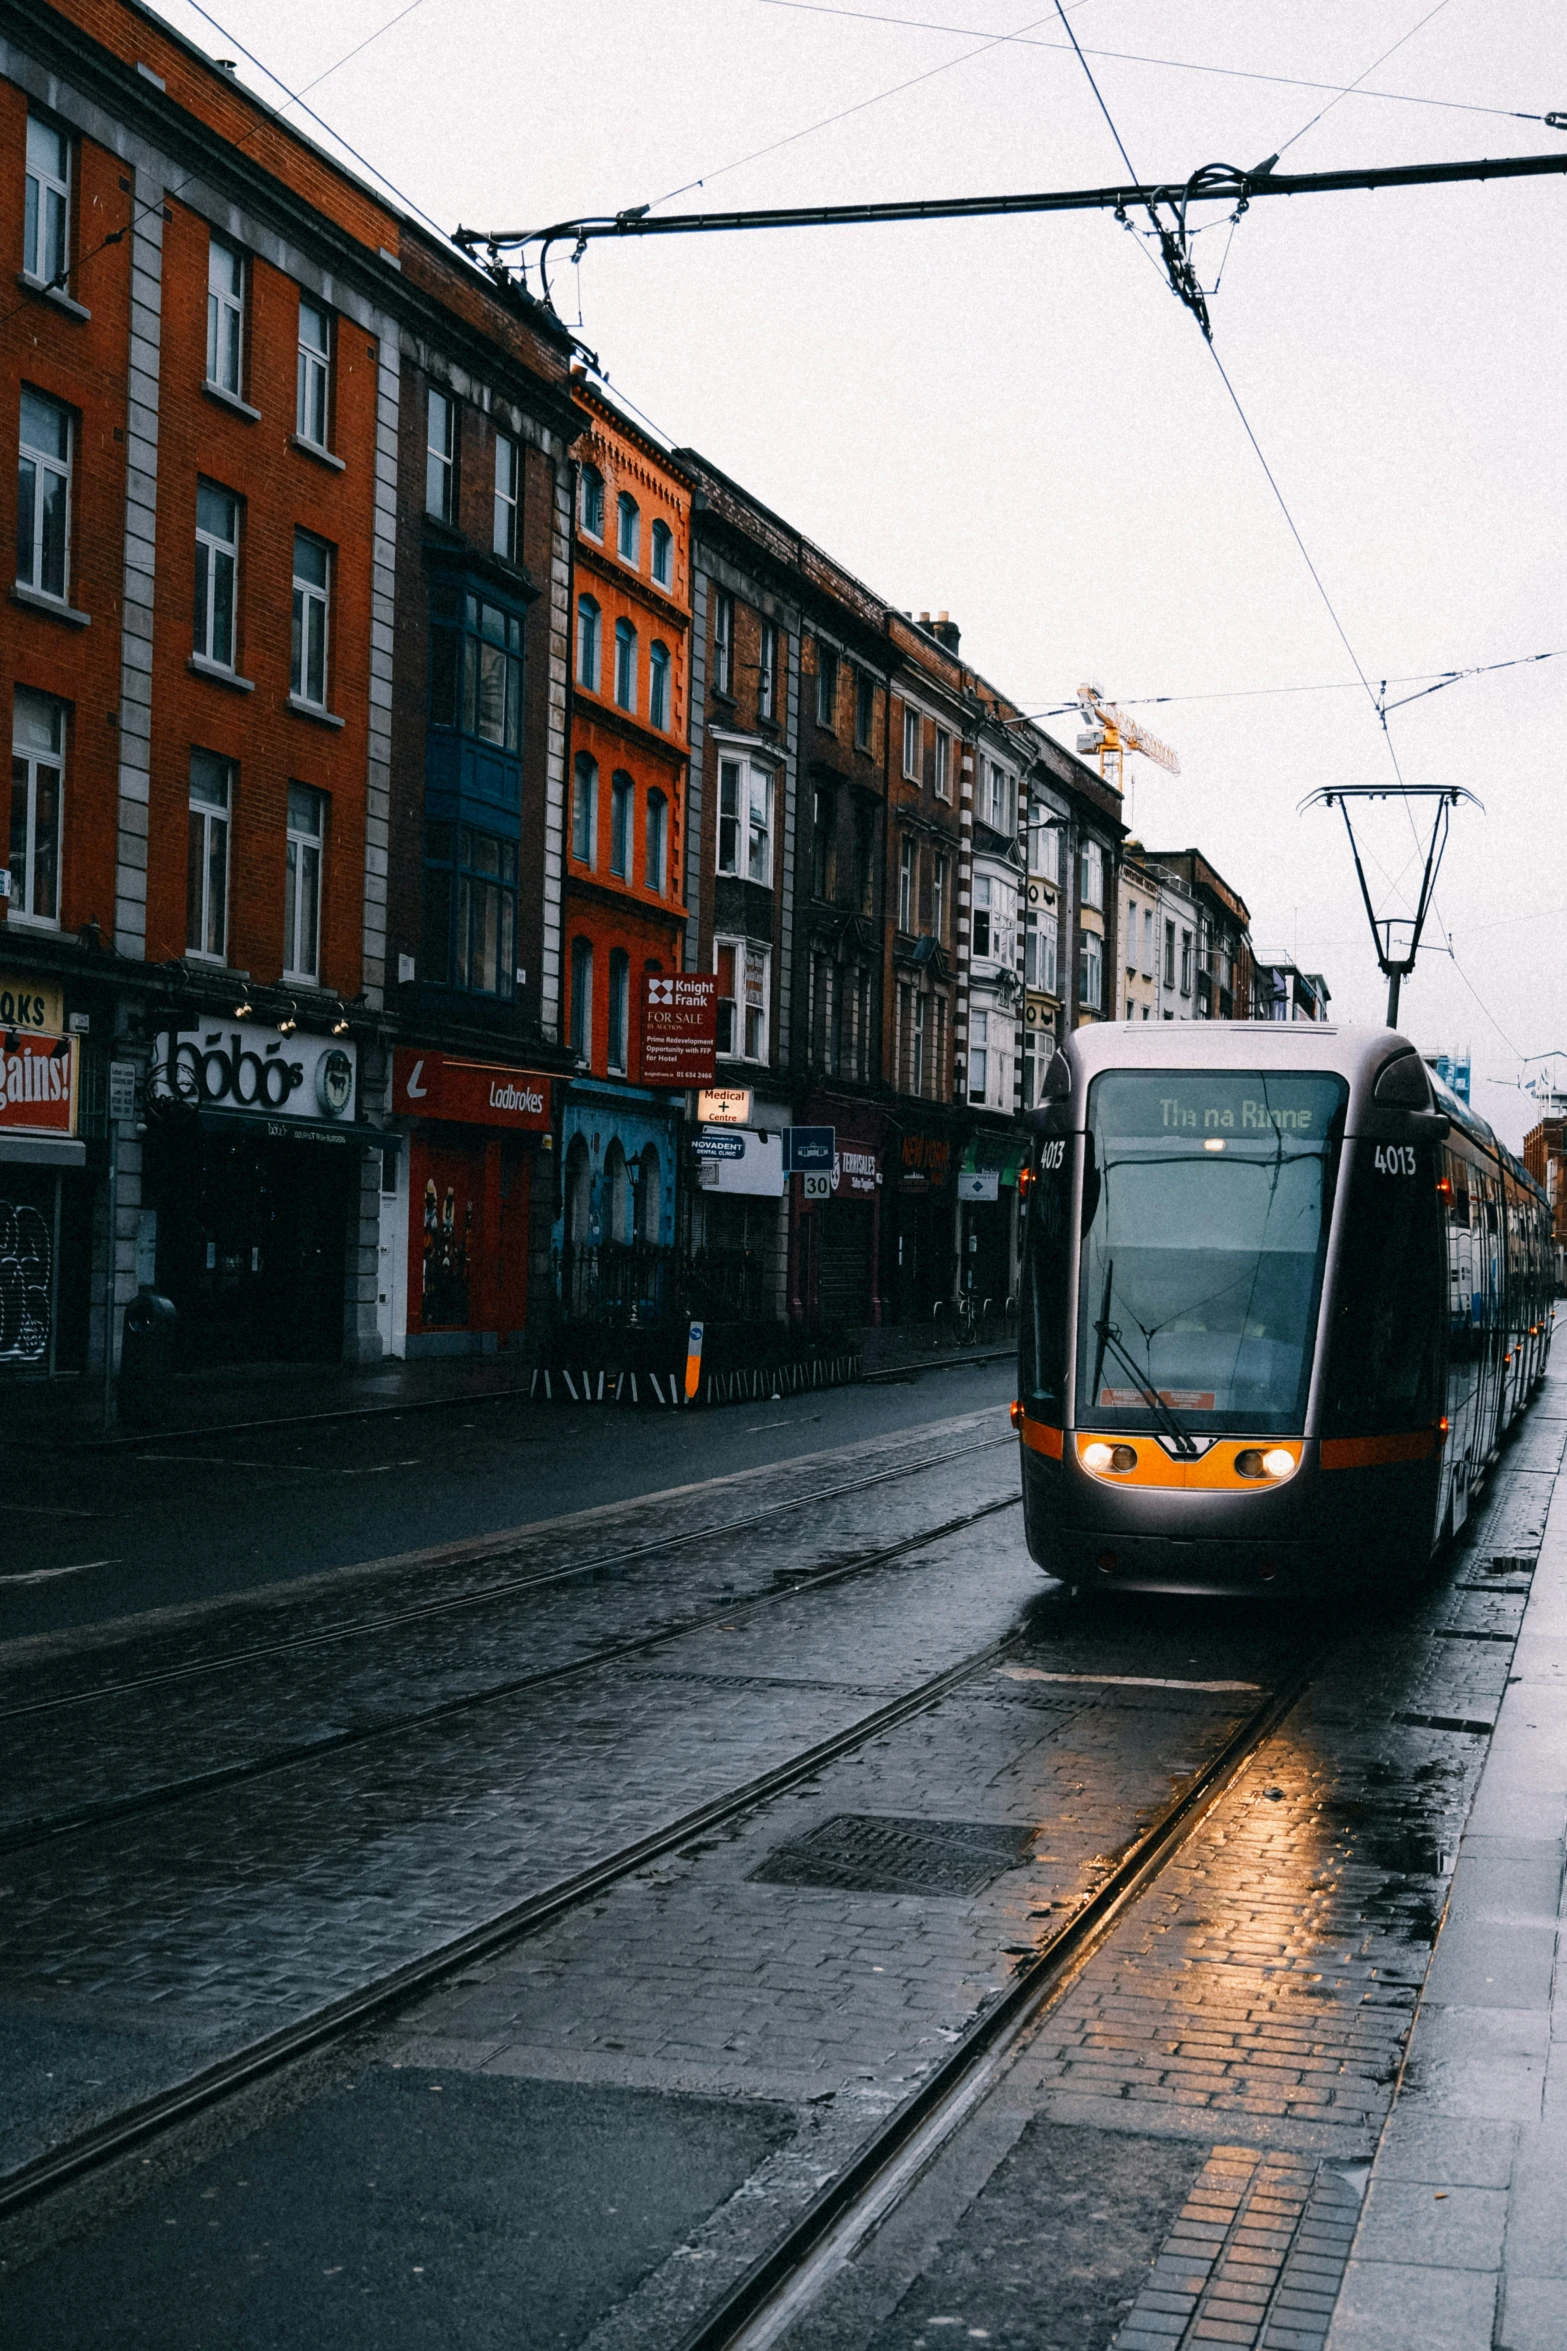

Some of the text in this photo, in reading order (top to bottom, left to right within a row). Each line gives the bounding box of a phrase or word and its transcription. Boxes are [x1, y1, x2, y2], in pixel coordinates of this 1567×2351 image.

[675, 980, 714, 995] Knight
[675, 994, 708, 1007] Frank
[648, 1011, 704, 1025] FOR SALE
[646, 1035, 714, 1046] Prime Redevelopment
[646, 1044, 684, 1055] Opportunity
[489, 1071, 544, 1114] Ladbrokes
[704, 1090, 745, 1101] Medical
[708, 1113, 737, 1122] Centre
[1204, 1109, 1234, 1128] na
[1242, 1099, 1313, 1128] Rinne
[691, 1140, 743, 1152] NOVADENT
[696, 1148, 737, 1157] DENTAL CLINIC
[1041, 1140, 1066, 1169] 4013
[1374, 1145, 1416, 1175] 4013
[806, 1177, 827, 1194] 30
